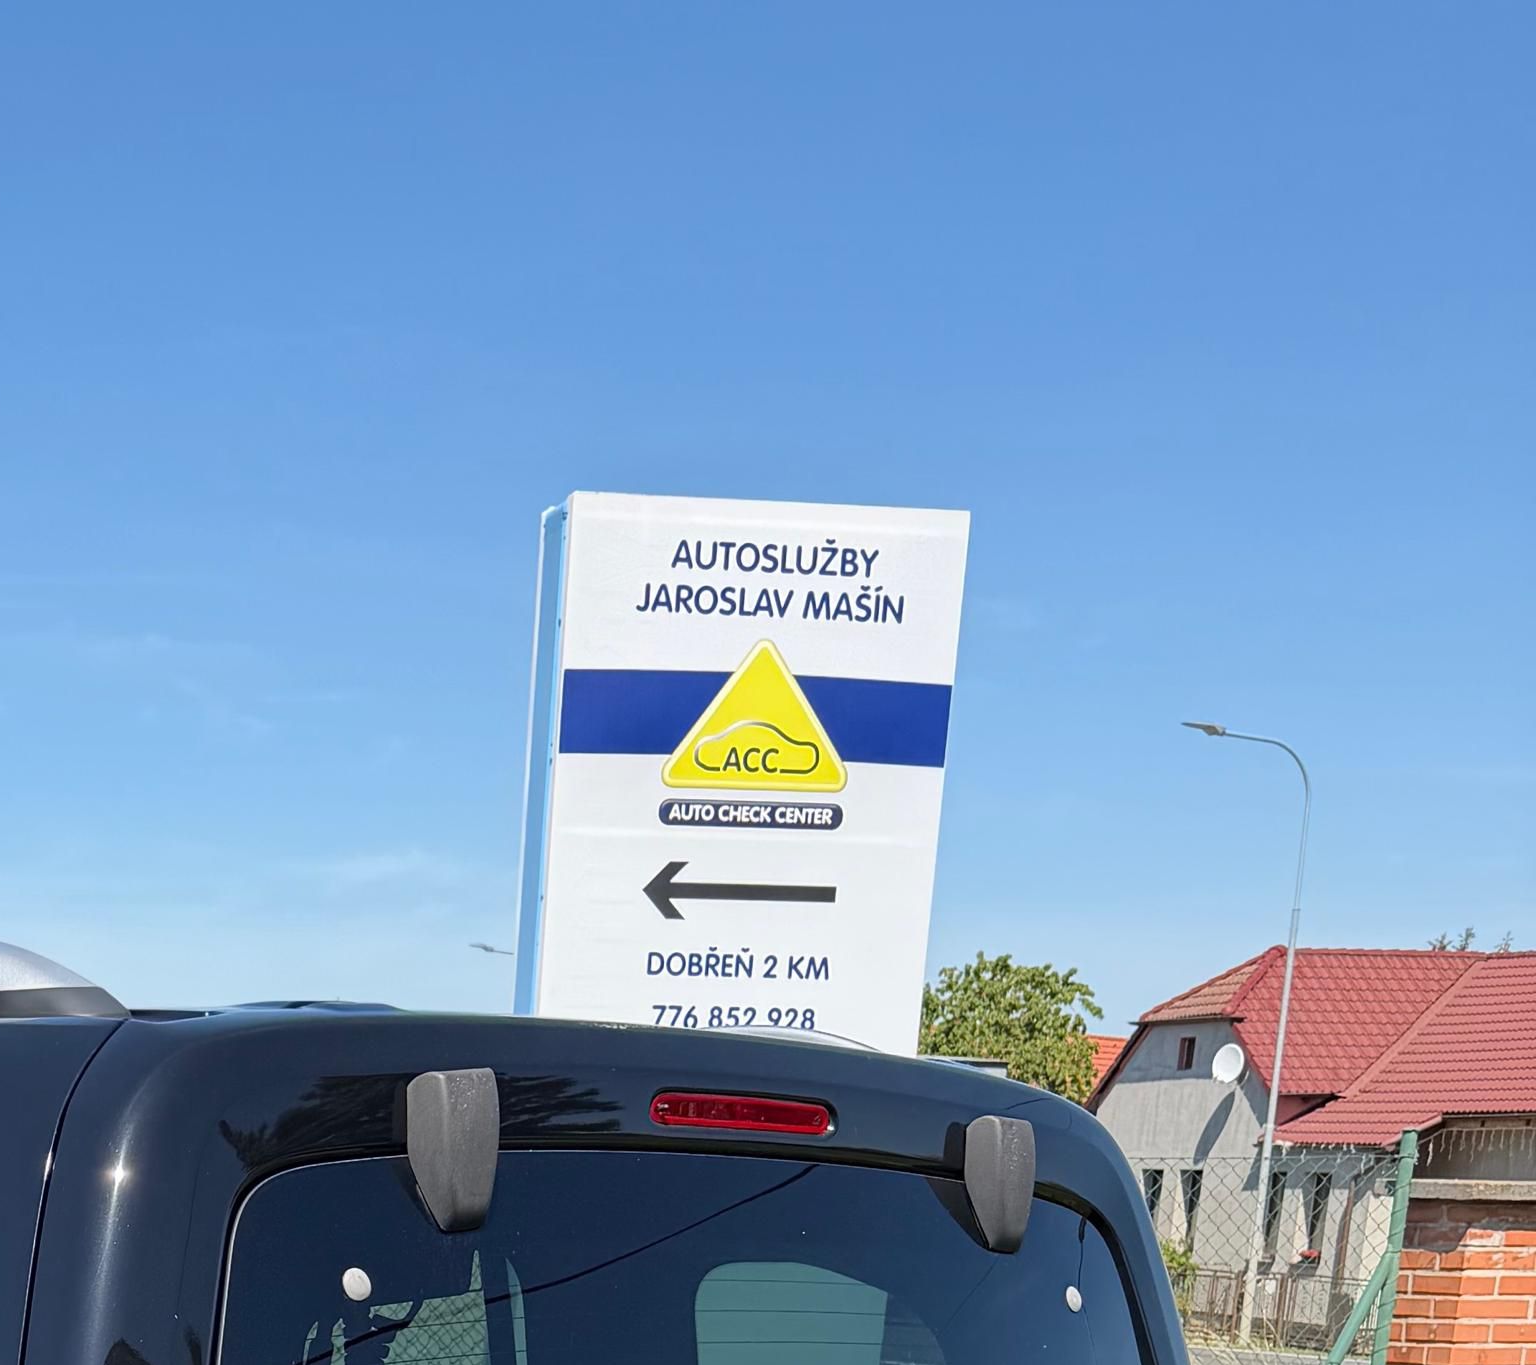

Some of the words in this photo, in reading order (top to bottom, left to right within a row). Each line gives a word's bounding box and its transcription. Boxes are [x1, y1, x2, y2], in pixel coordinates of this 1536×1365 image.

[671, 538, 880, 578] AUTOSLUŽBY
[636, 582, 794, 618] JAROSLAV
[802, 584, 905, 625] MAŠÍN
[721, 746, 780, 774] ACC
[668, 803, 715, 822] AUTO
[717, 805, 772, 824] CHECK
[774, 806, 834, 826] CENTER
[646, 946, 754, 979] DOBŘEŇ
[762, 954, 778, 979] 2
[787, 955, 830, 981] KM
[652, 1004, 699, 1029] 776
[708, 1006, 757, 1029] 852
[767, 1007, 815, 1031] 928
